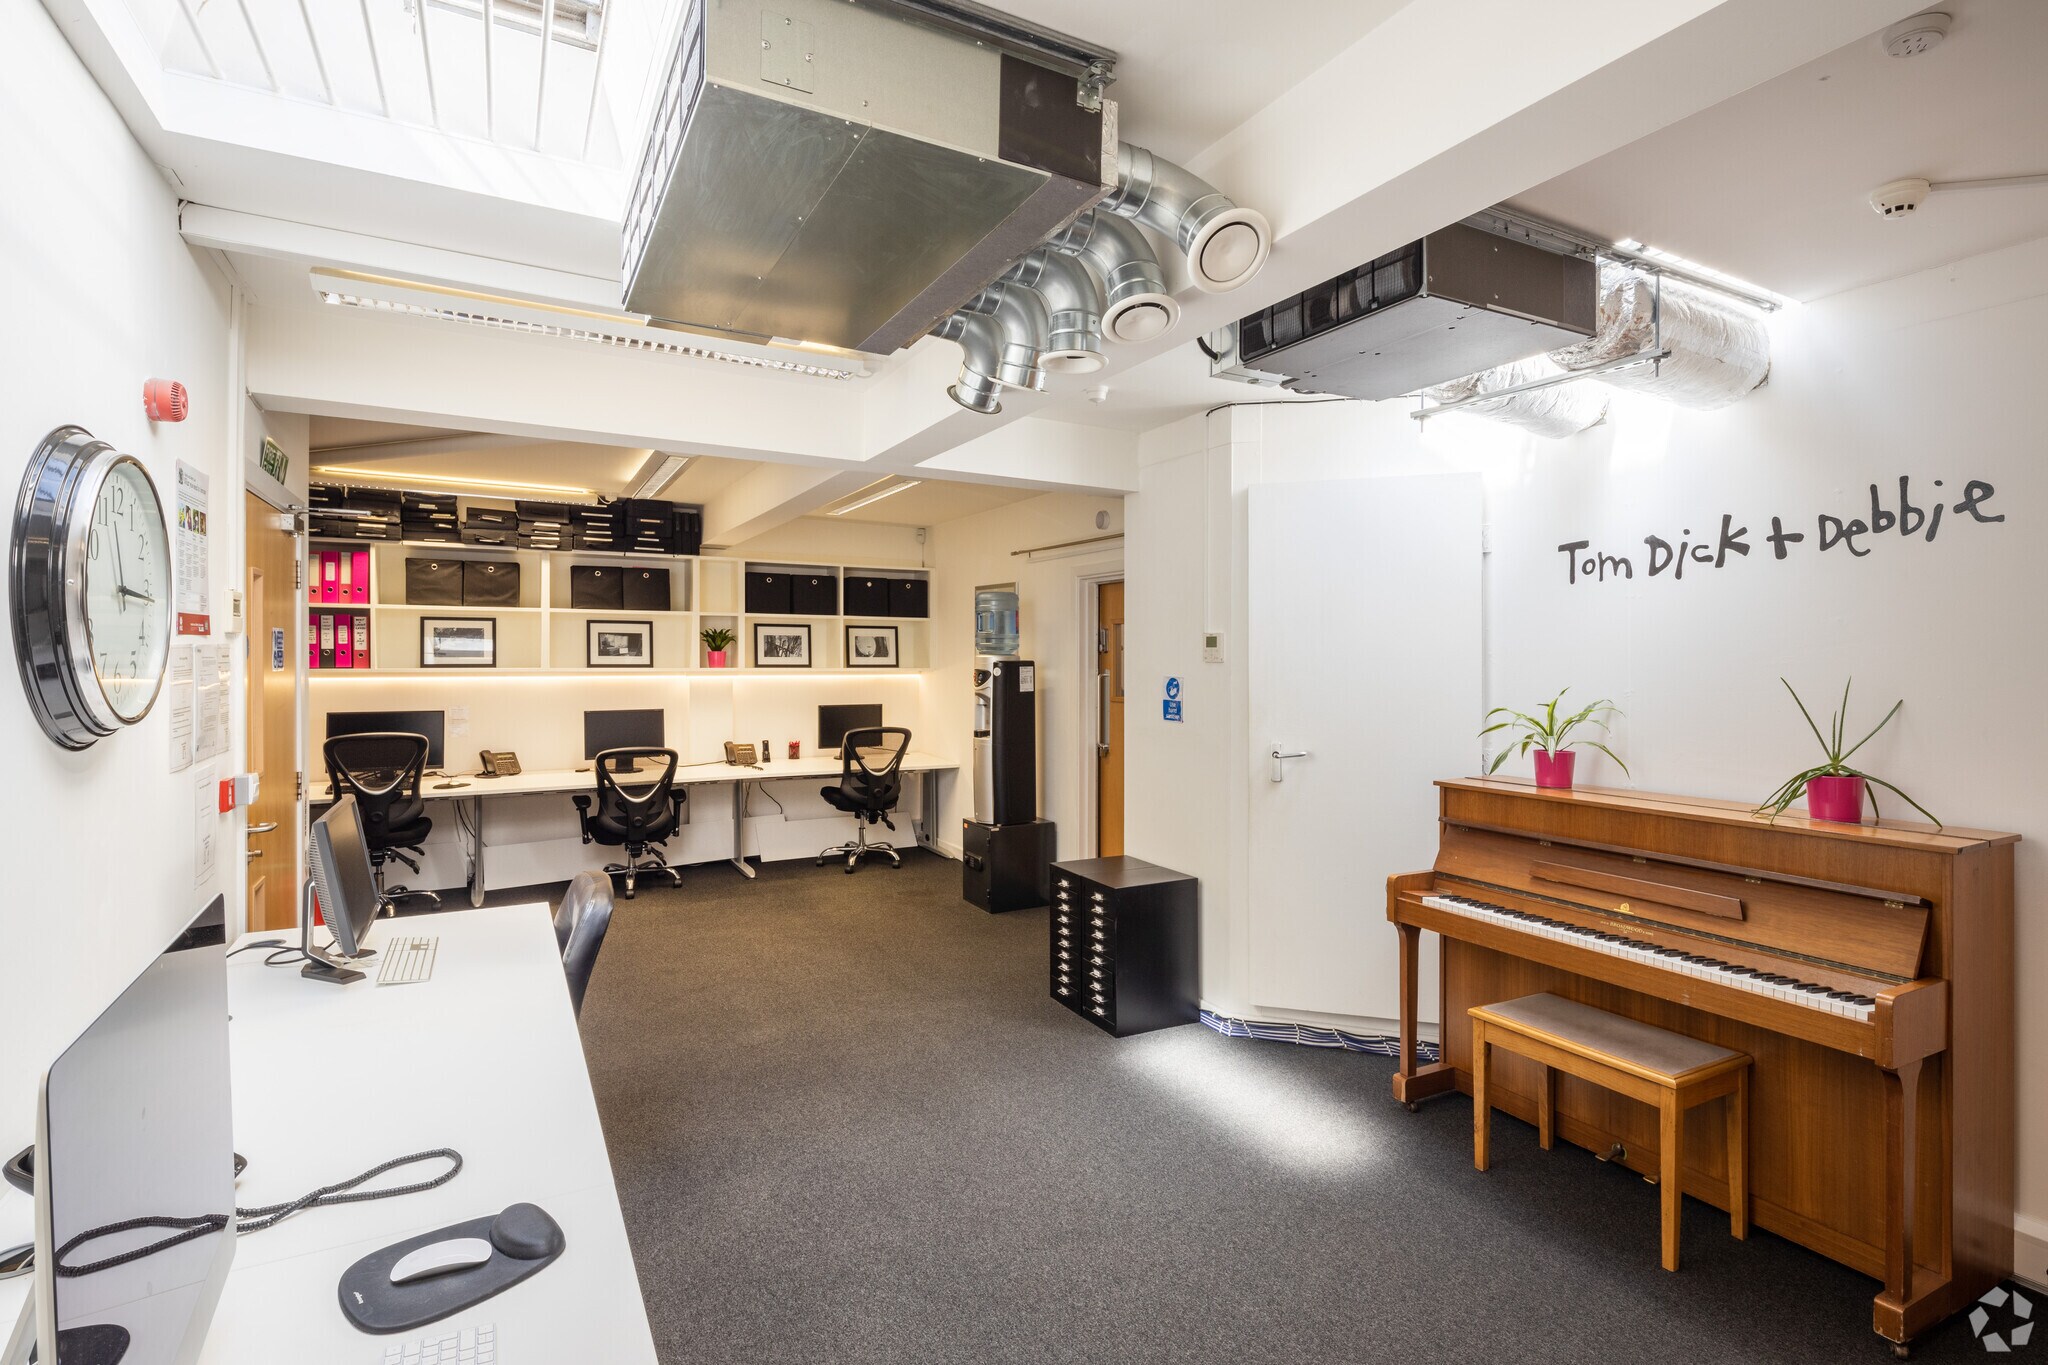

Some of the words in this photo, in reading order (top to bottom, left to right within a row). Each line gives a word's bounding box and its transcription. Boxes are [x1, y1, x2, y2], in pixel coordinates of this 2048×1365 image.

[98, 495, 109, 527] 11
[111, 485, 124, 517] 12
[129, 504, 135, 532] 1
[1558, 540, 1633, 585] Tom
[1644, 514, 1750, 580] Dick
[1766, 516, 1805, 560] +
[1818, 476, 2006, 558] Debbie
[87, 528, 99, 561] 0
[138, 534, 145, 561] 2
[143, 578, 151, 607] 3
[138, 620, 146, 646] 4
[100, 652, 108, 680] 7
[113, 662, 122, 695] 6
[130, 650, 138, 680] 5
